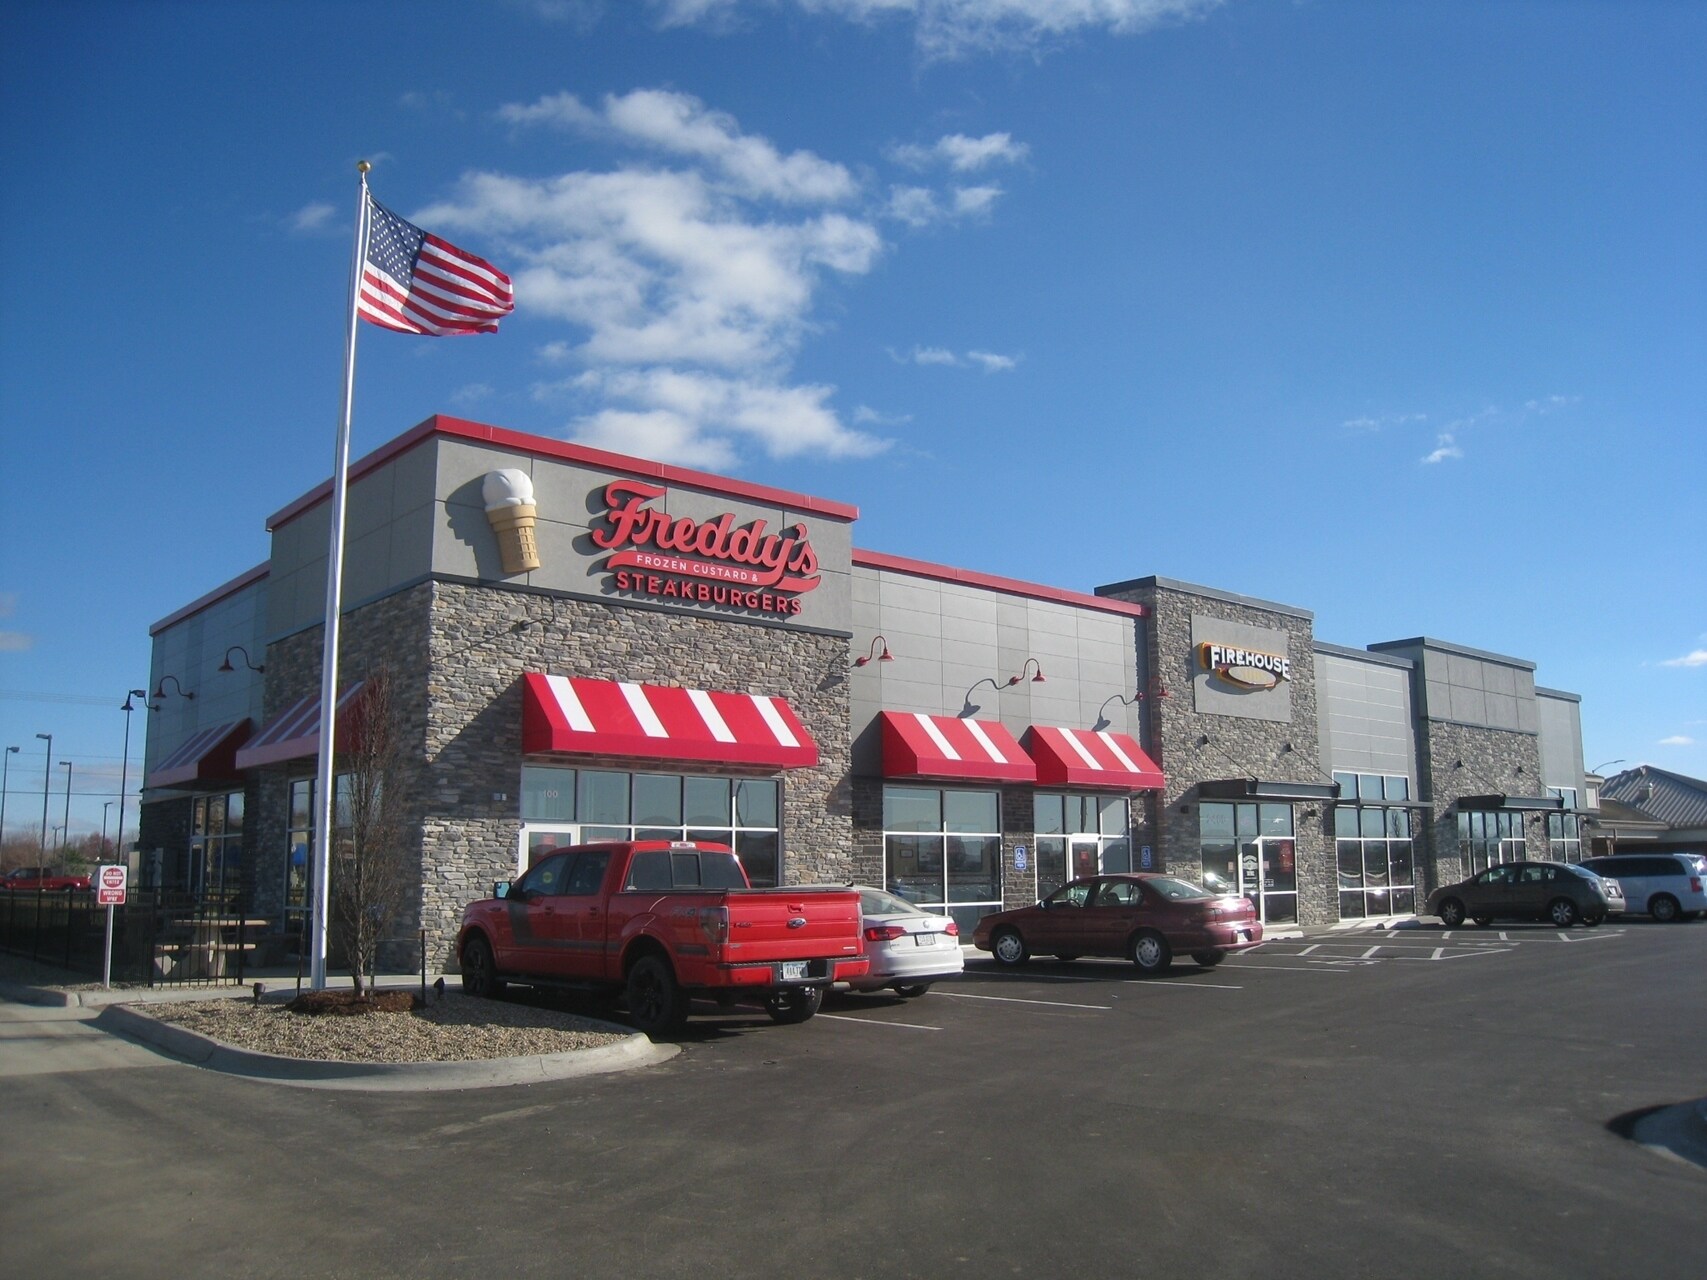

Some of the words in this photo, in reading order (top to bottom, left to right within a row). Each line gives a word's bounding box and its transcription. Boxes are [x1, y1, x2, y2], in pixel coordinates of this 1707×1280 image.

[592, 479, 819, 585] Freddy's
[636, 554, 687, 571] FROZEN
[692, 563, 748, 581] CUSTARD
[751, 573, 758, 582] &
[616, 571, 802, 615] STEAKBURGERS
[1210, 645, 1291, 681] FIREHOUSE
